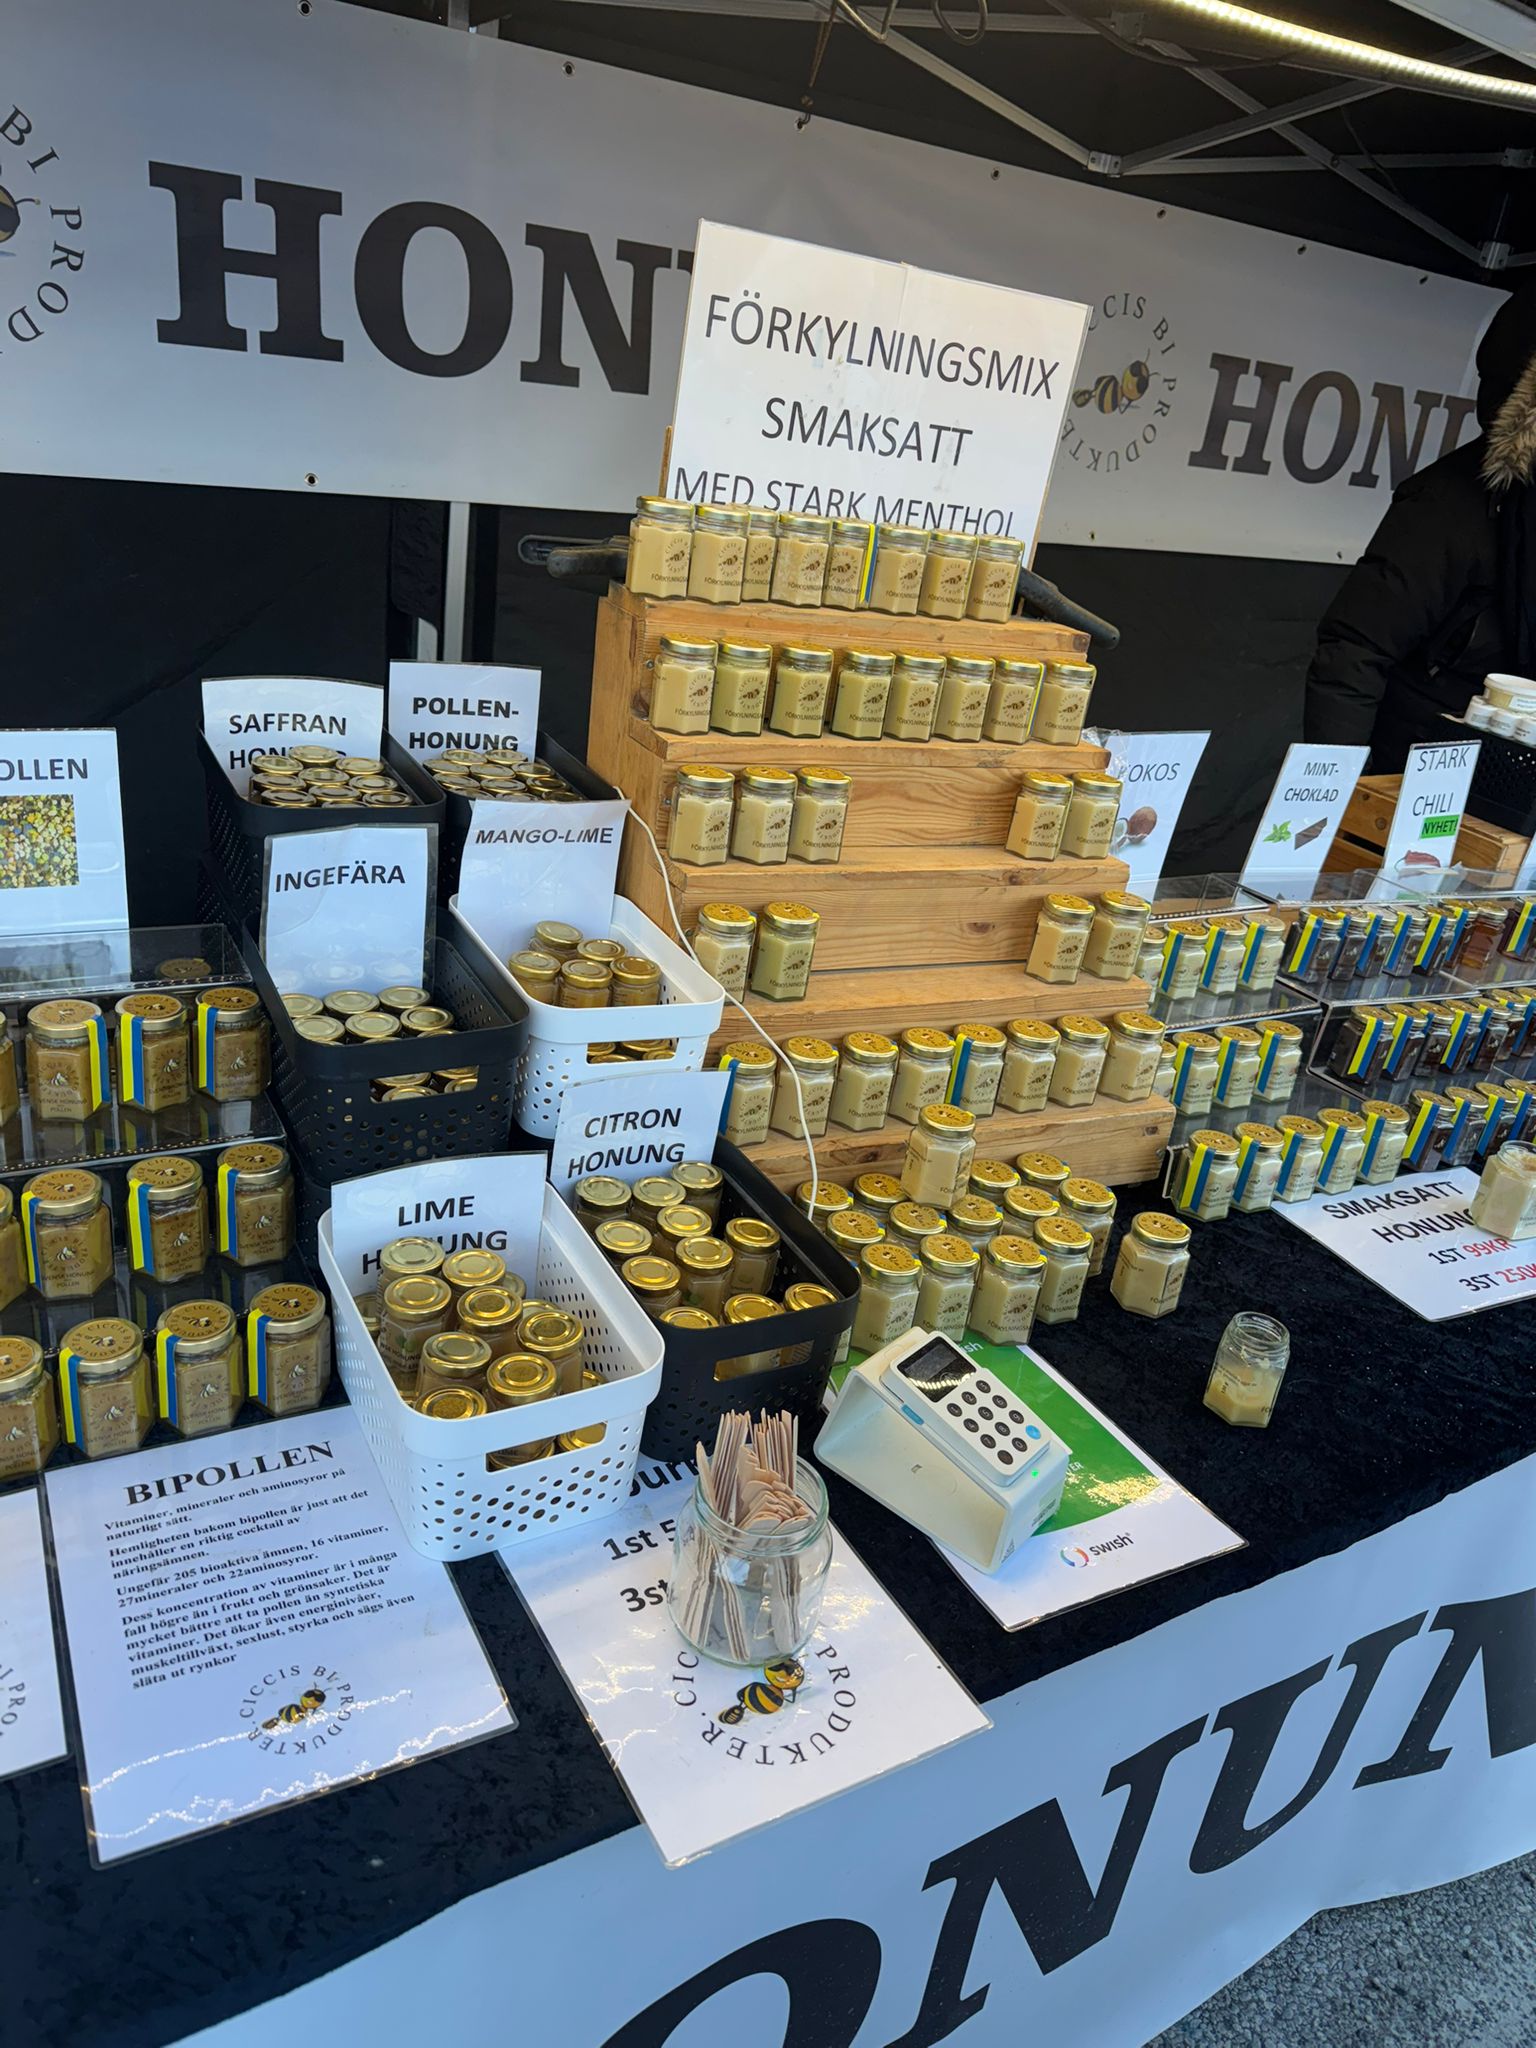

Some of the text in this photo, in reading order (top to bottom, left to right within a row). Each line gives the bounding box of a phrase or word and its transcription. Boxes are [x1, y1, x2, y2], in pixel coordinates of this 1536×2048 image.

[148, 160, 697, 397] HON
[705, 289, 1060, 400] FÖRKYLNINGSMIX
[761, 397, 974, 467] SMAKSATT
[675, 466, 754, 505] MED
[763, 480, 867, 519] STARK
[412, 696, 520, 719] POLLEN-
[229, 712, 347, 736] SAFFRAN
[409, 731, 520, 752] HONUNG
[1304, 762, 1339, 776] MINT-
[1417, 746, 1470, 772] STARK
[1284, 787, 1339, 803] CHOKLAD
[1412, 792, 1455, 817] CHILI
[475, 827, 614, 845] MANGO-LIME
[1421, 818, 1458, 837] NYHET!
[275, 860, 405, 893] INGEFÄRA
[584, 1107, 682, 1138] CITRON
[567, 1142, 685, 1179] HONUNG
[398, 1195, 475, 1227] LIME
[1322, 1180, 1464, 1219] SMAKSATT
[362, 1230, 508, 1275] HUNG
[1428, 1247, 1467, 1265] 1ST
[1458, 1273, 1500, 1291] 3ST
[123, 1440, 335, 1506] BIPOLLEN
[176, 1494, 235, 1513] mineraler
[239, 1488, 259, 1498] och
[262, 1473, 328, 1493] aminosyror
[332, 1469, 346, 1479] på
[194, 1521, 236, 1536] bakom
[240, 1509, 287, 1525] bipollen
[291, 1505, 303, 1513] är
[307, 1499, 329, 1511] just
[332, 1495, 348, 1504] att
[351, 1491, 368, 1499] det
[199, 1533, 234, 1546] riktig
[237, 1519, 284, 1536] cocktail
[287, 1517, 300, 1525] av
[602, 1529, 659, 1562] 1st
[117, 1577, 170, 1596] Ungefär
[174, 1568, 197, 1581] 205
[200, 1555, 260, 1574] bioaktiva
[312, 1538, 325, 1547] 16
[203, 1574, 225, 1585] och
[122, 1612, 153, 1626] Dess
[157, 1588, 248, 1616] koncentration
[252, 1583, 266, 1592] av
[270, 1568, 330, 1586] vitaminer
[334, 1564, 346, 1572] är
[358, 1552, 398, 1566] många
[124, 1625, 146, 1638] fall
[150, 1616, 189, 1631] högre
[193, 1610, 209, 1619] än
[221, 1597, 255, 1612] frukt
[258, 1591, 281, 1602] och
[353, 1569, 374, 1579] Det
[378, 1565, 390, 1573] är
[127, 1579, 385, 1650] mycket bättre att ta pollen än syntetiska
[204, 1630, 227, 1642] Det
[231, 1622, 261, 1635] ökar
[266, 1613, 295, 1626] även
[288, 1618, 329, 1633] styrka
[332, 1610, 354, 1621] och
[358, 1604, 384, 1615] sägs
[386, 1595, 415, 1607] även
[171, 1668, 185, 1678] ut
[190, 1654, 237, 1674] rynkor
